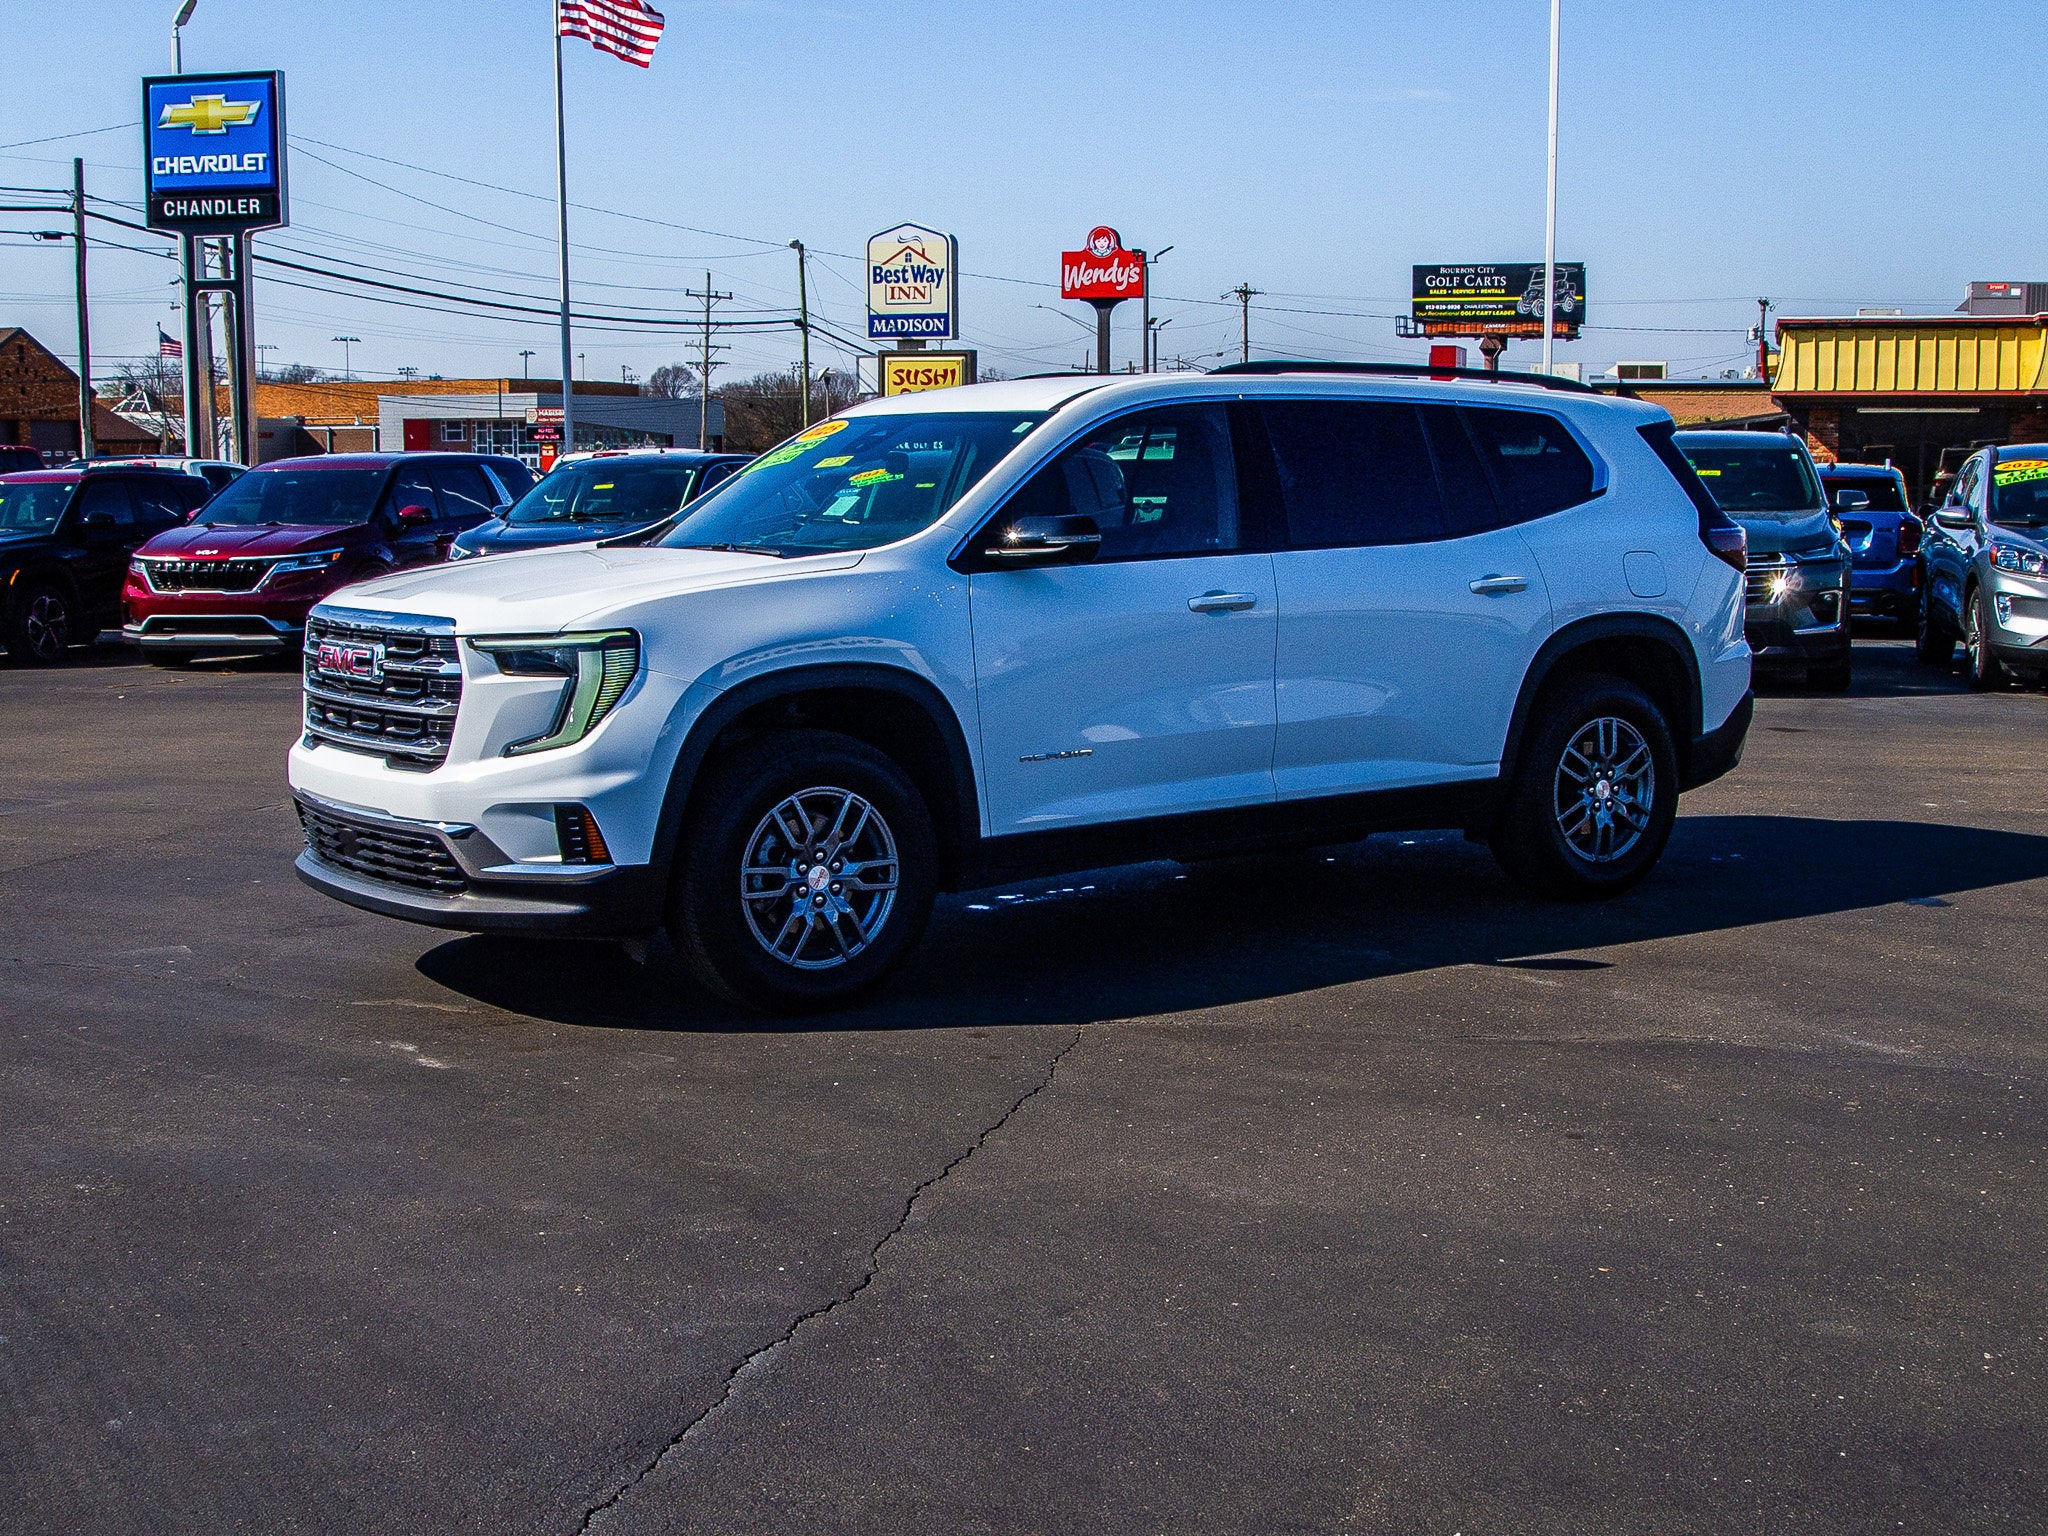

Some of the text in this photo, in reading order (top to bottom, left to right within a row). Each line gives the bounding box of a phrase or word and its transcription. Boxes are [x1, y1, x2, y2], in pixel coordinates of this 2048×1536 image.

[153, 153, 267, 175] CHEVROLET
[163, 199, 260, 216] CHANDLER
[873, 265, 945, 289] Best Way
[1064, 257, 1140, 292] Wendy's
[1440, 266, 1496, 274] BOURBON CITY
[1425, 274, 1507, 287] GOLF CARTS
[889, 285, 927, 300] INN
[873, 318, 945, 333] MADISON
[892, 368, 956, 386] SUSHI
[318, 645, 370, 675] GMC
